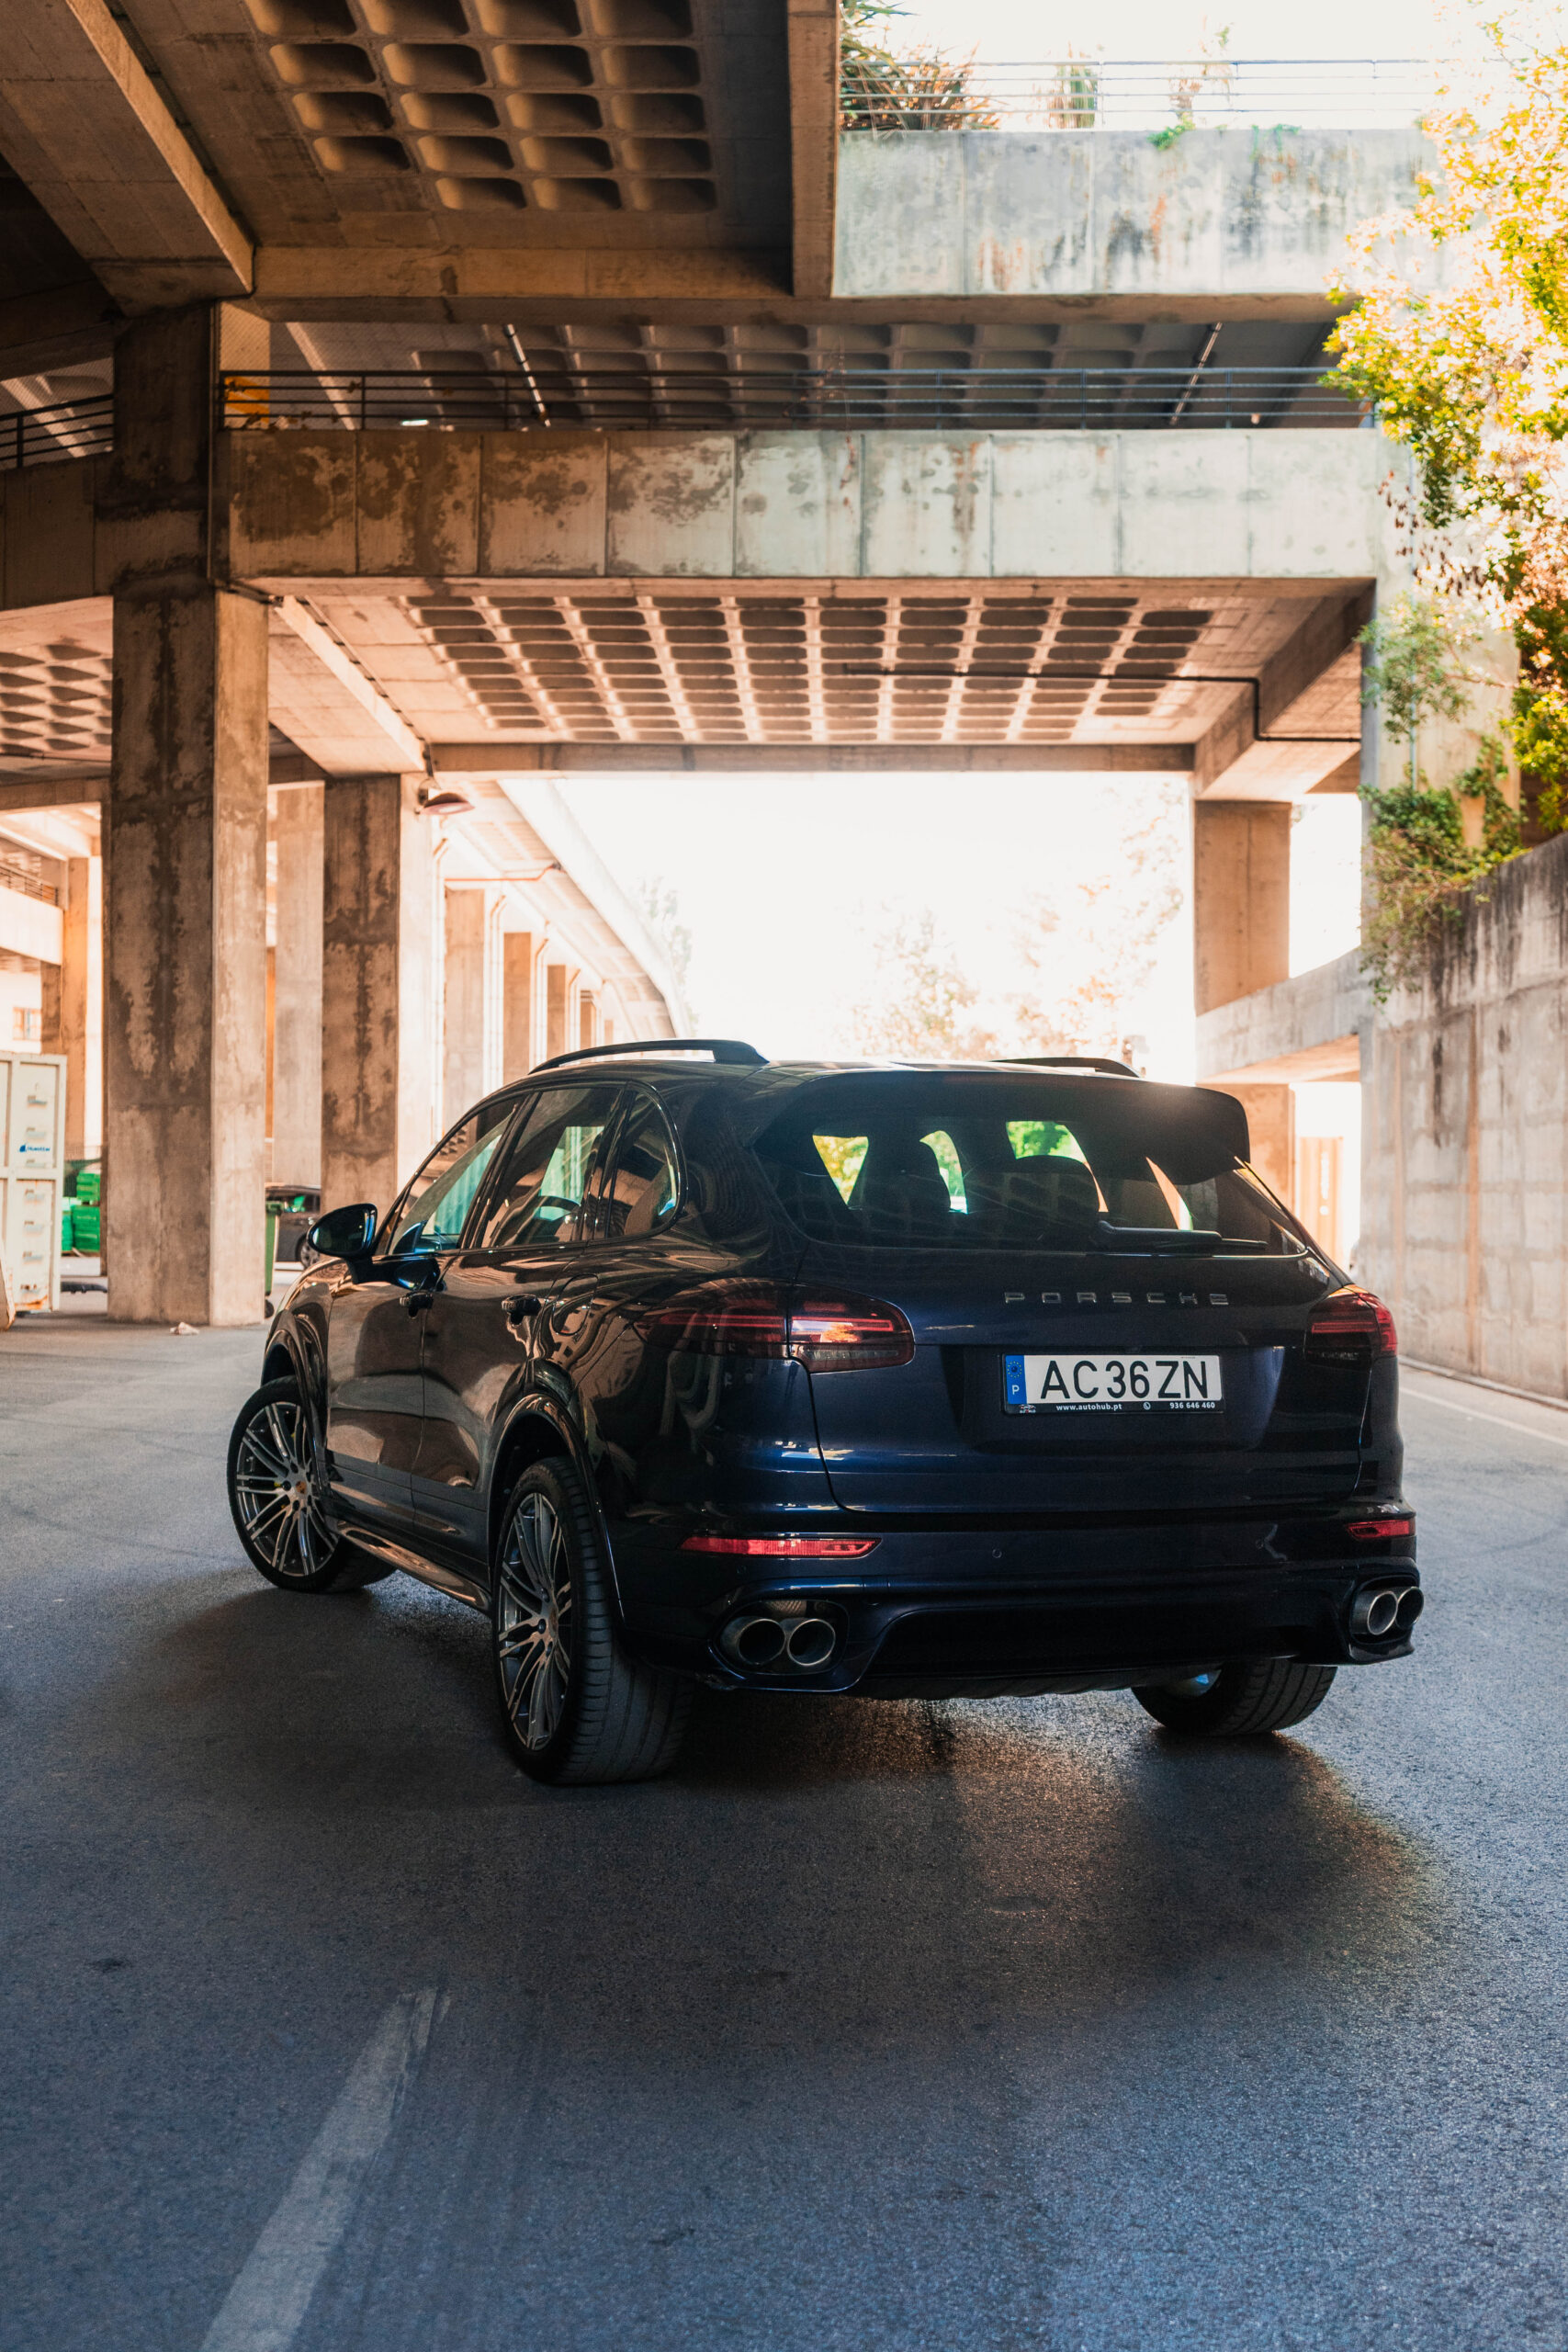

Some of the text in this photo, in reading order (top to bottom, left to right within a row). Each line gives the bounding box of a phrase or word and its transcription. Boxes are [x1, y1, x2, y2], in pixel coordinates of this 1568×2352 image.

[1004, 1292, 1229, 1306] PORSCHE
[1011, 1385, 1020, 1395] P
[1055, 1403, 1122, 1411] www.autohub.pt
